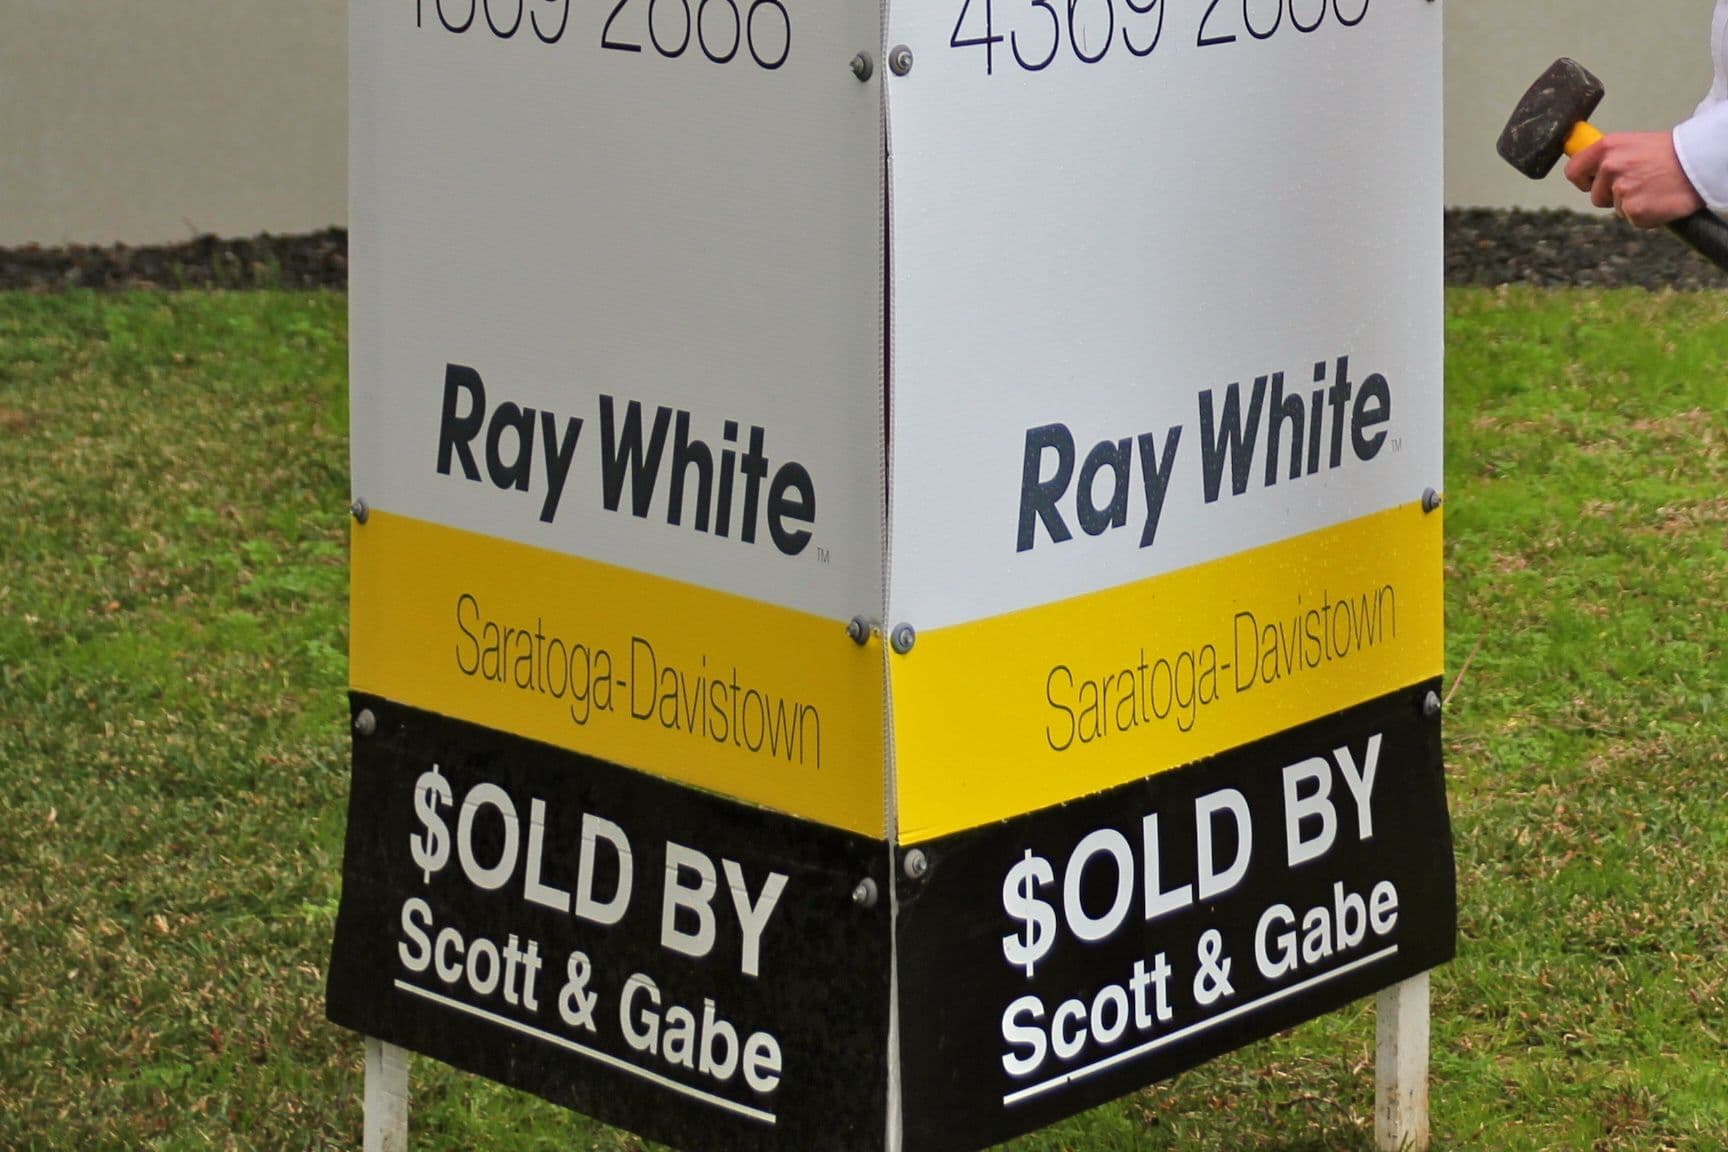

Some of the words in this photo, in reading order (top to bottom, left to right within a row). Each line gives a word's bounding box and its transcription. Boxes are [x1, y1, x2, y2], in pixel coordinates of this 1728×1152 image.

[436, 362, 584, 523] Ray
[599, 393, 816, 556] White
[1016, 422, 1183, 553] Ray
[1198, 355, 1391, 504] White
[455, 592, 821, 769] Saratoga-Davistown
[1045, 583, 1397, 752] Saratoga-Davistown
[409, 764, 633, 925] $OLD
[660, 840, 789, 978] BY
[1002, 788, 1253, 978] $OLD
[1282, 732, 1383, 868] BY
[398, 897, 542, 1012] Scott
[558, 950, 597, 1032] &
[619, 972, 782, 1093] Gabe
[1001, 952, 1173, 1077] Scott
[1193, 928, 1235, 1007] &
[1254, 880, 1399, 979] Gabe
